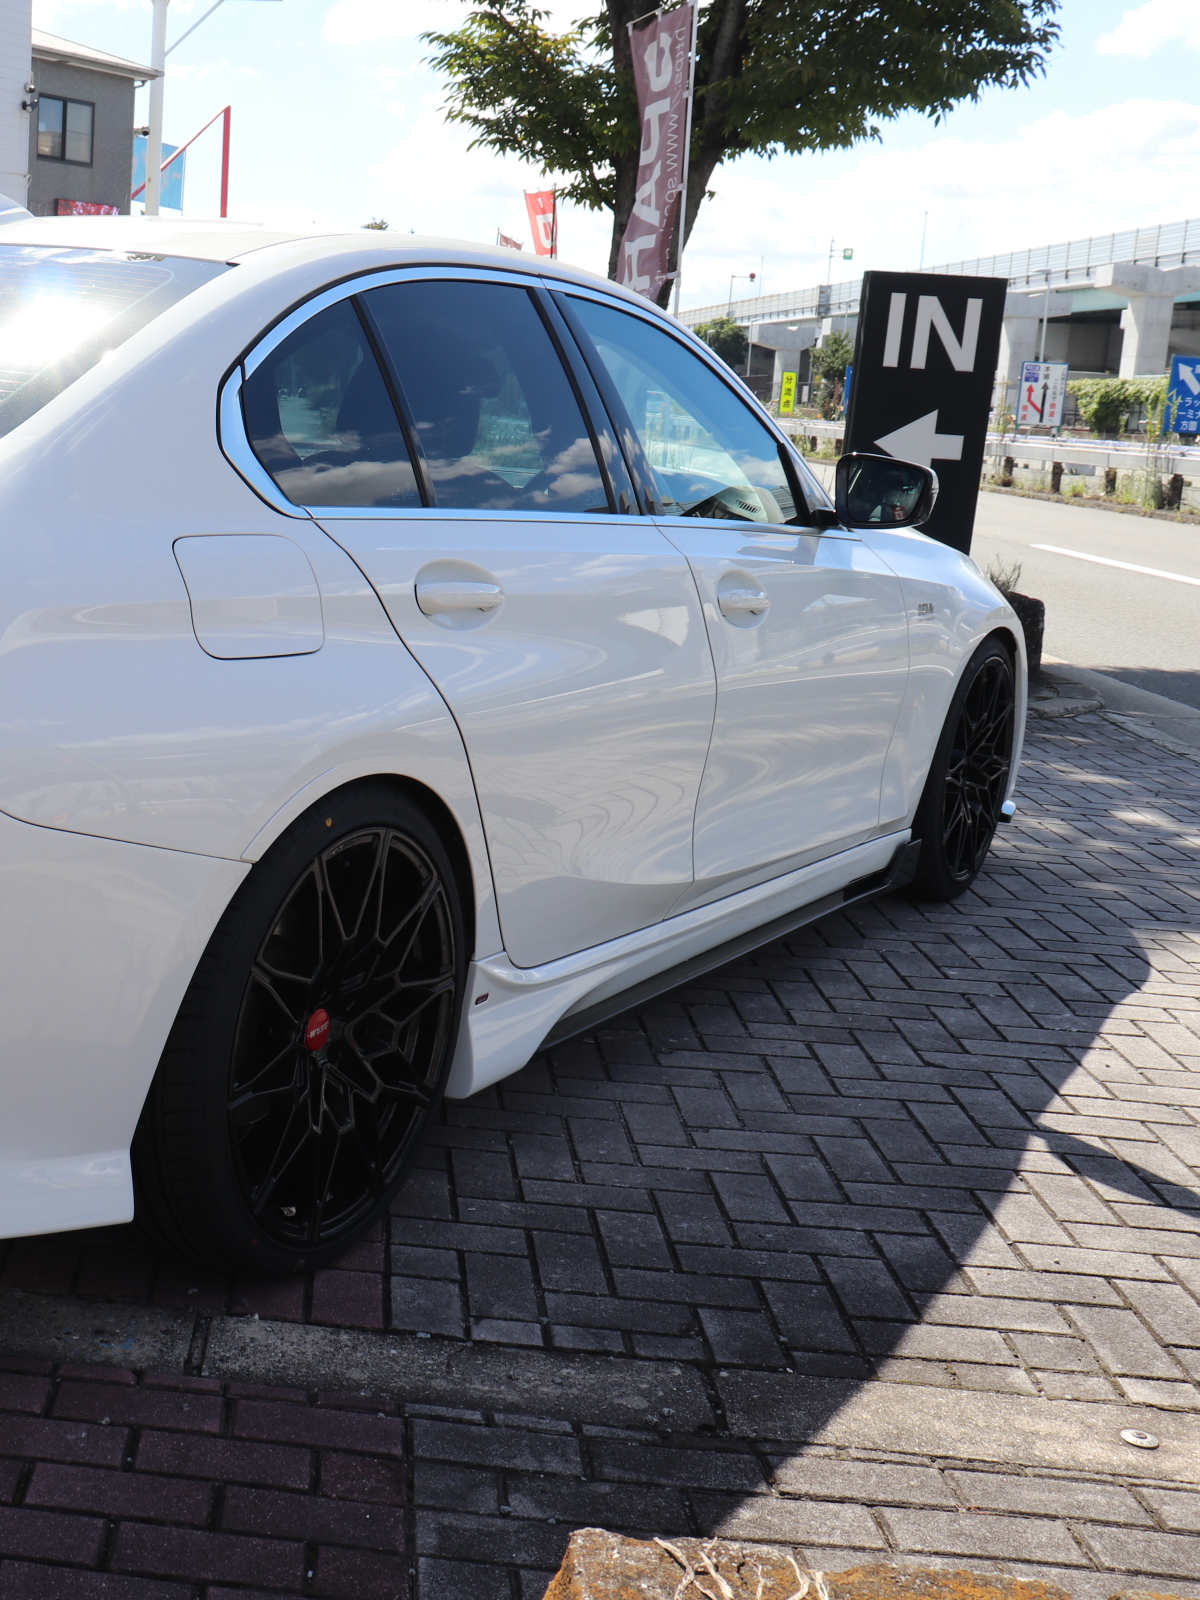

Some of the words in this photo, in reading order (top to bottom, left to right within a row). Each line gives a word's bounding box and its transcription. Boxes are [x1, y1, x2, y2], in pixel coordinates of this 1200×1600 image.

[883, 292, 983, 372] IN
[783, 375, 793, 408] 分流点
[1180, 420, 1198, 431] 方面
